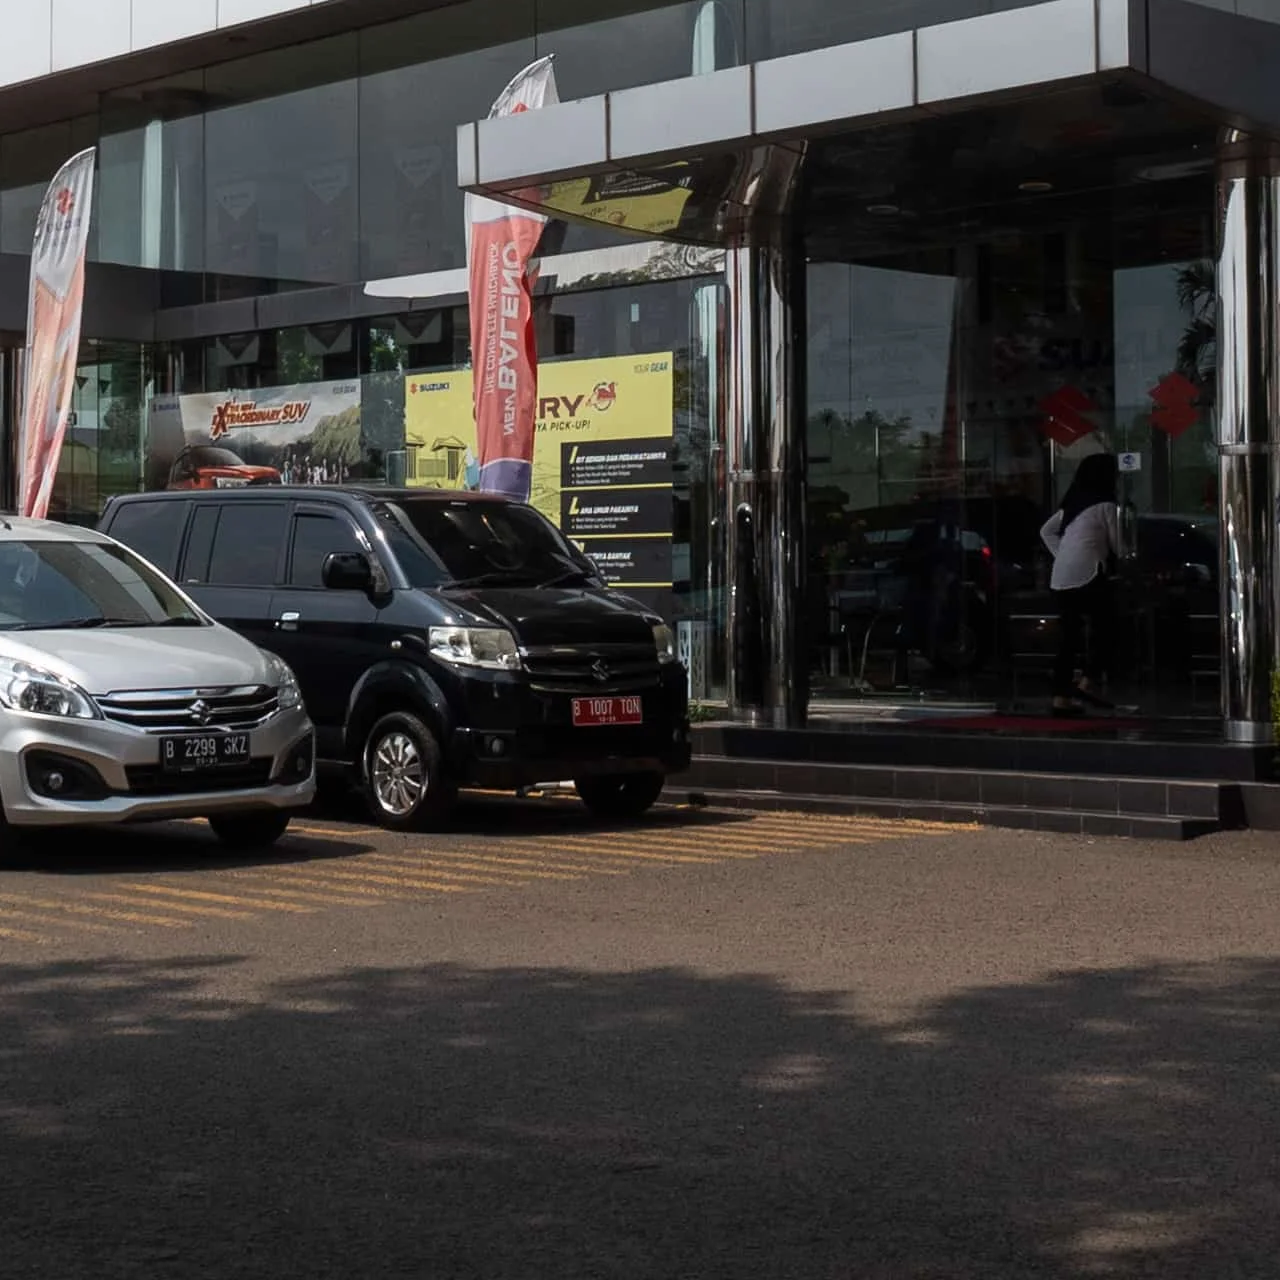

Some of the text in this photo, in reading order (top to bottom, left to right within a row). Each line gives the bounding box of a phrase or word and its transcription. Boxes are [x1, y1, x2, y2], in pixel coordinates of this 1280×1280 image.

[650, 361, 669, 372] GEAR
[419, 381, 450, 393] SUZUKI
[280, 402, 309, 423] SUV
[549, 419, 591, 433] PICK-UP!
[574, 700, 582, 717] B
[589, 698, 614, 716] 1007
[166, 740, 175, 759] B
[185, 737, 217, 758] 2299
